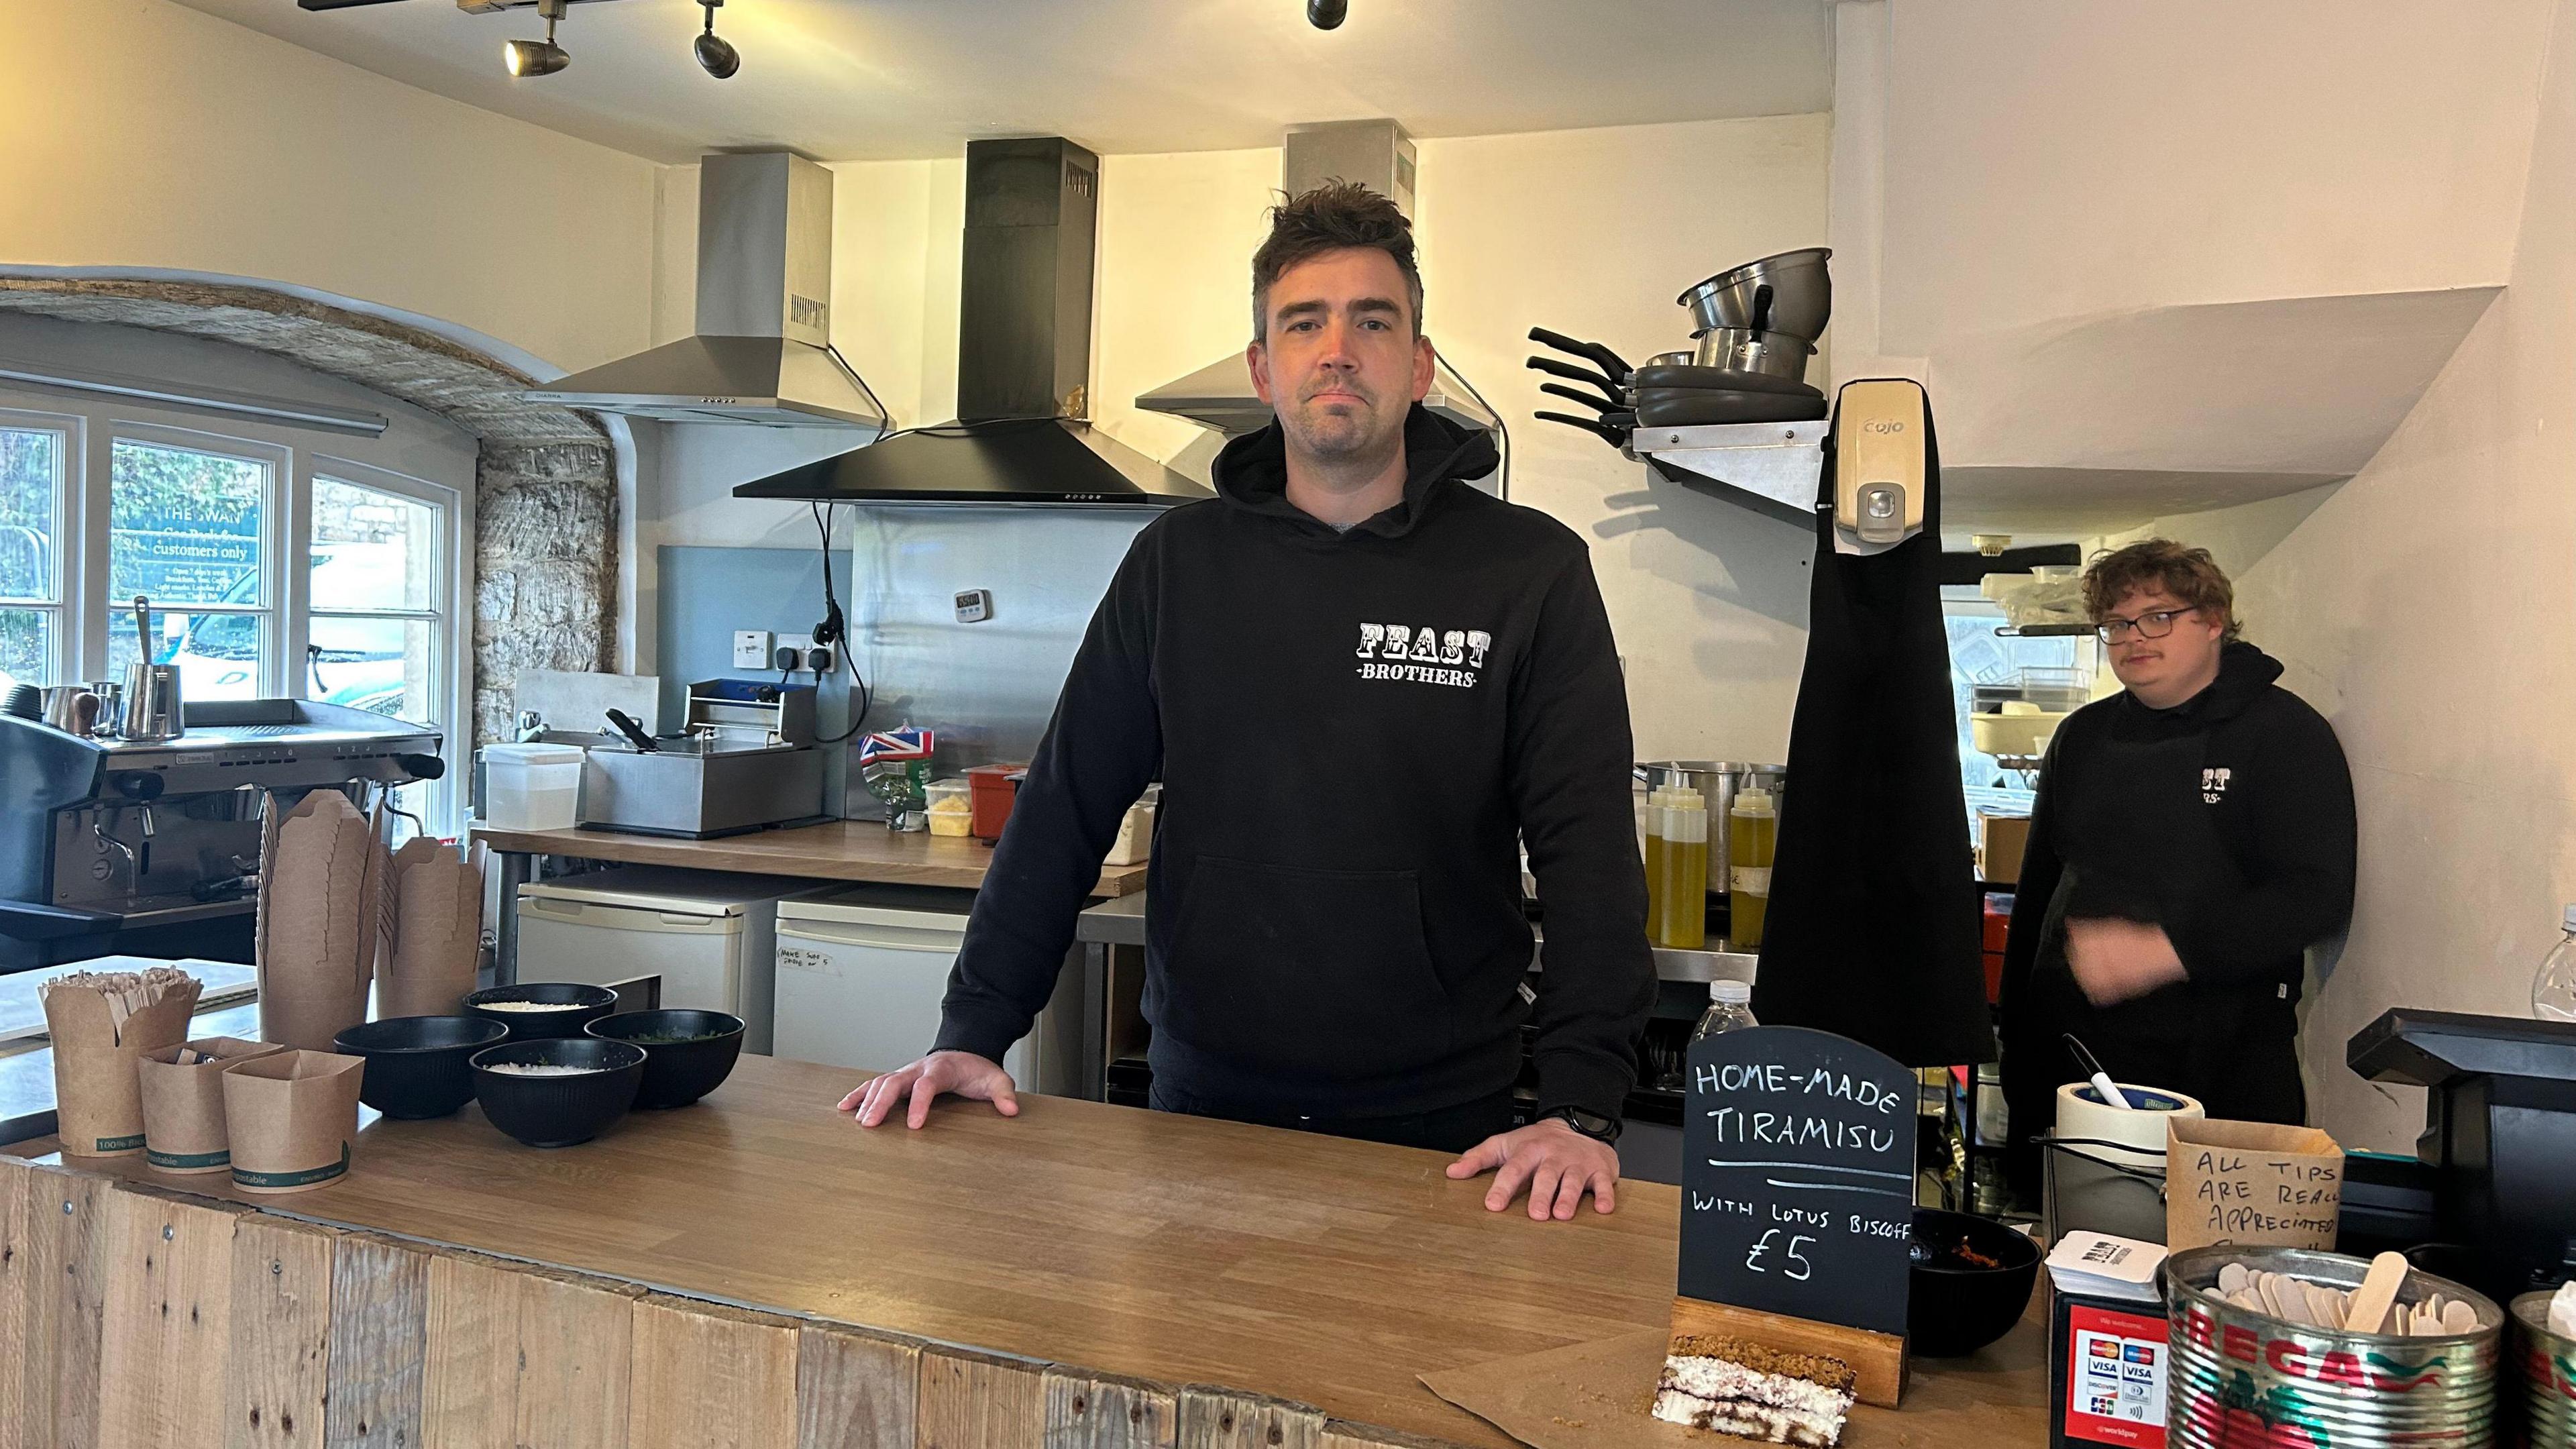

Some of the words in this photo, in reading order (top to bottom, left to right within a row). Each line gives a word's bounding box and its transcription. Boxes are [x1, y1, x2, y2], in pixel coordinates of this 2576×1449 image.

[153, 545, 217, 558] customers
[221, 545, 248, 561] only
[1356, 623, 1491, 668] FEAST
[1696, 1063, 1900, 1114] HOME-MADE
[99, 1140, 125, 1149] 100%
[1707, 1107, 1894, 1152] TIRAMISU
[2197, 1151, 2247, 1175] ALL
[2268, 1163, 2336, 1182] TIPS
[2198, 1180, 2251, 1201] ARE
[1693, 1191, 1753, 1216] WITH
[1772, 1204, 1829, 1228] LOTUS
[1850, 1215, 1911, 1240] BISCOFF
[1746, 1229, 1817, 1281] £5
[2188, 1307, 2367, 1389] REGA
[2092, 1361, 2117, 1373] VISA
[2127, 1366, 2152, 1379] VISA
[2103, 1426, 2138, 1439] worldpay
